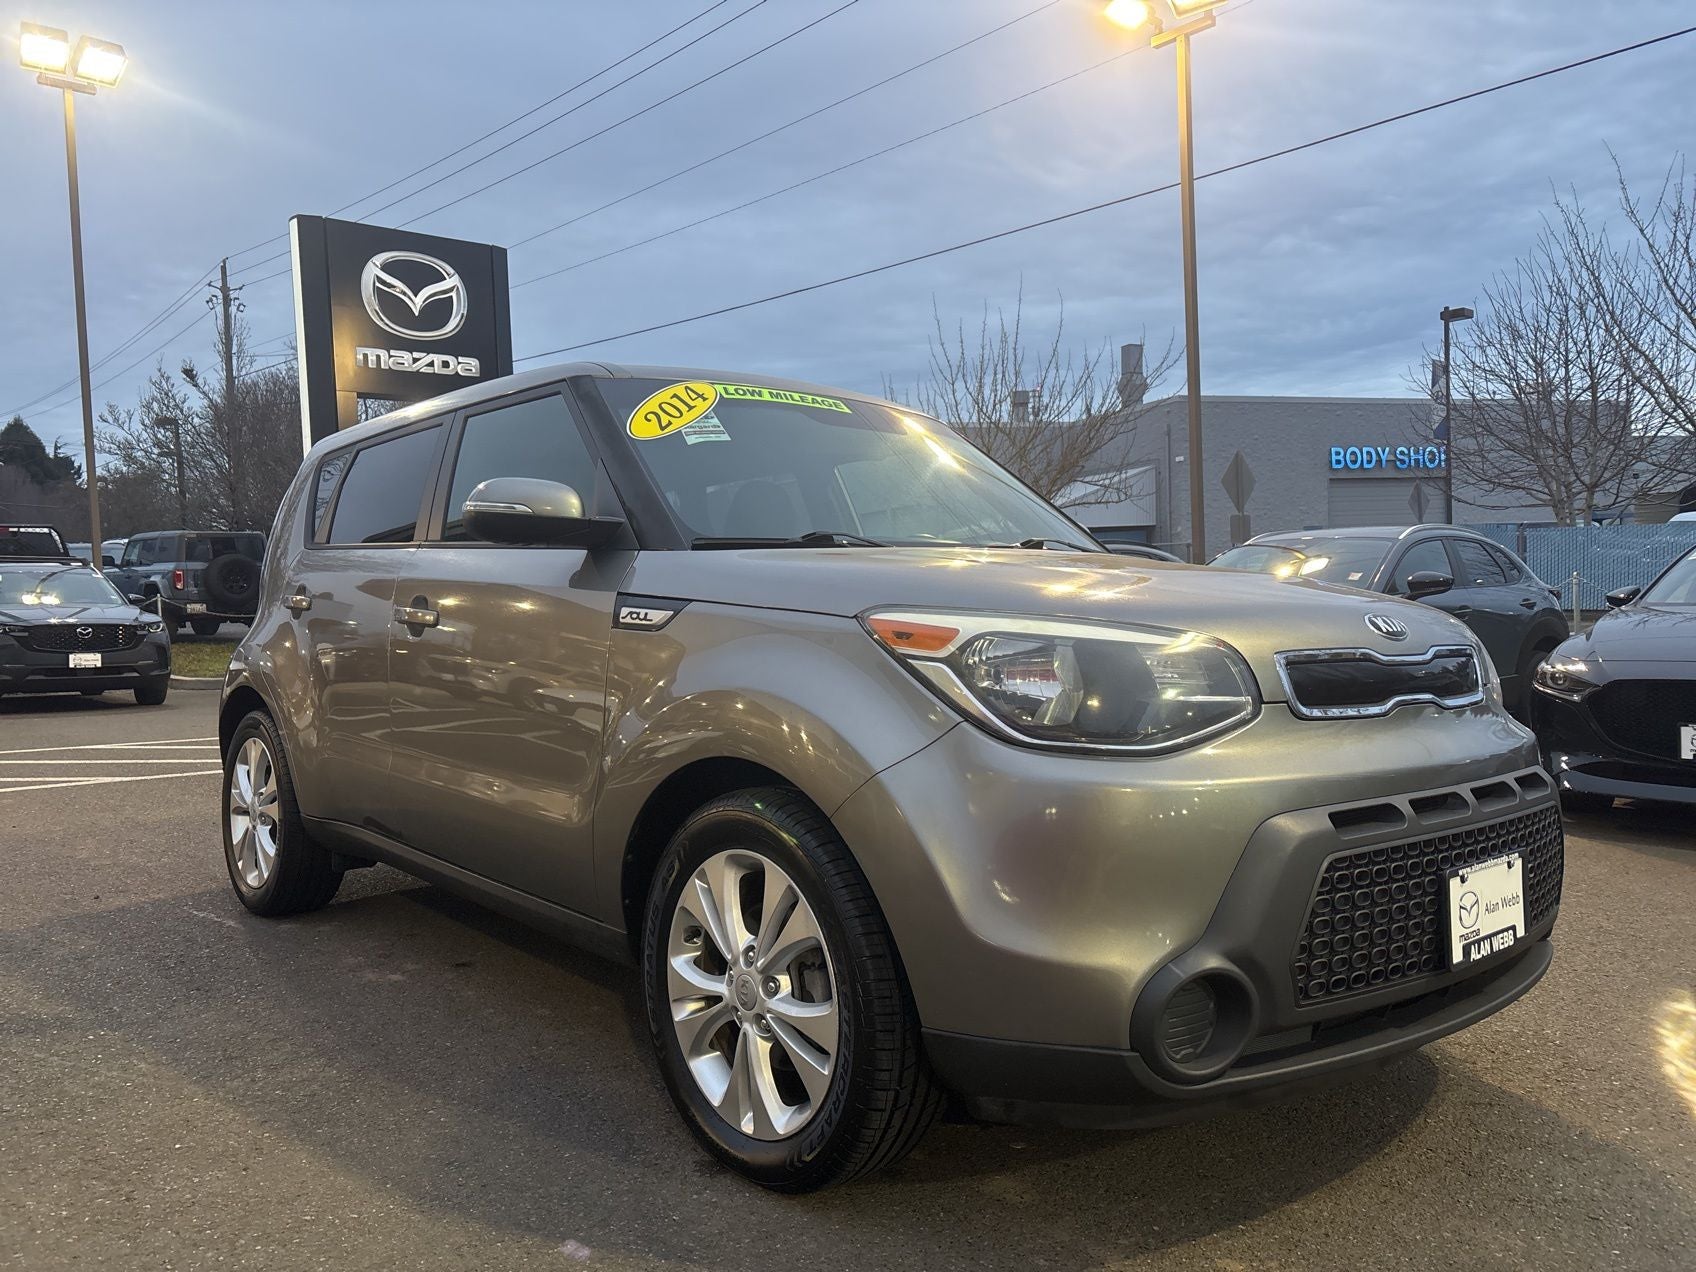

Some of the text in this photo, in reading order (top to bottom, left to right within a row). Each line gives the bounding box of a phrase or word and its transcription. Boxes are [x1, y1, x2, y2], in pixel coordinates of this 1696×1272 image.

[356, 347, 480, 377] mazda
[644, 384, 709, 431] 2014
[722, 386, 845, 411] LOW MILEAGE
[1330, 446, 1390, 470] BODY
[1370, 616, 1406, 633] KIA
[1484, 892, 1521, 917] Alan Webb
[1470, 930, 1515, 962] ALAN WEBB
